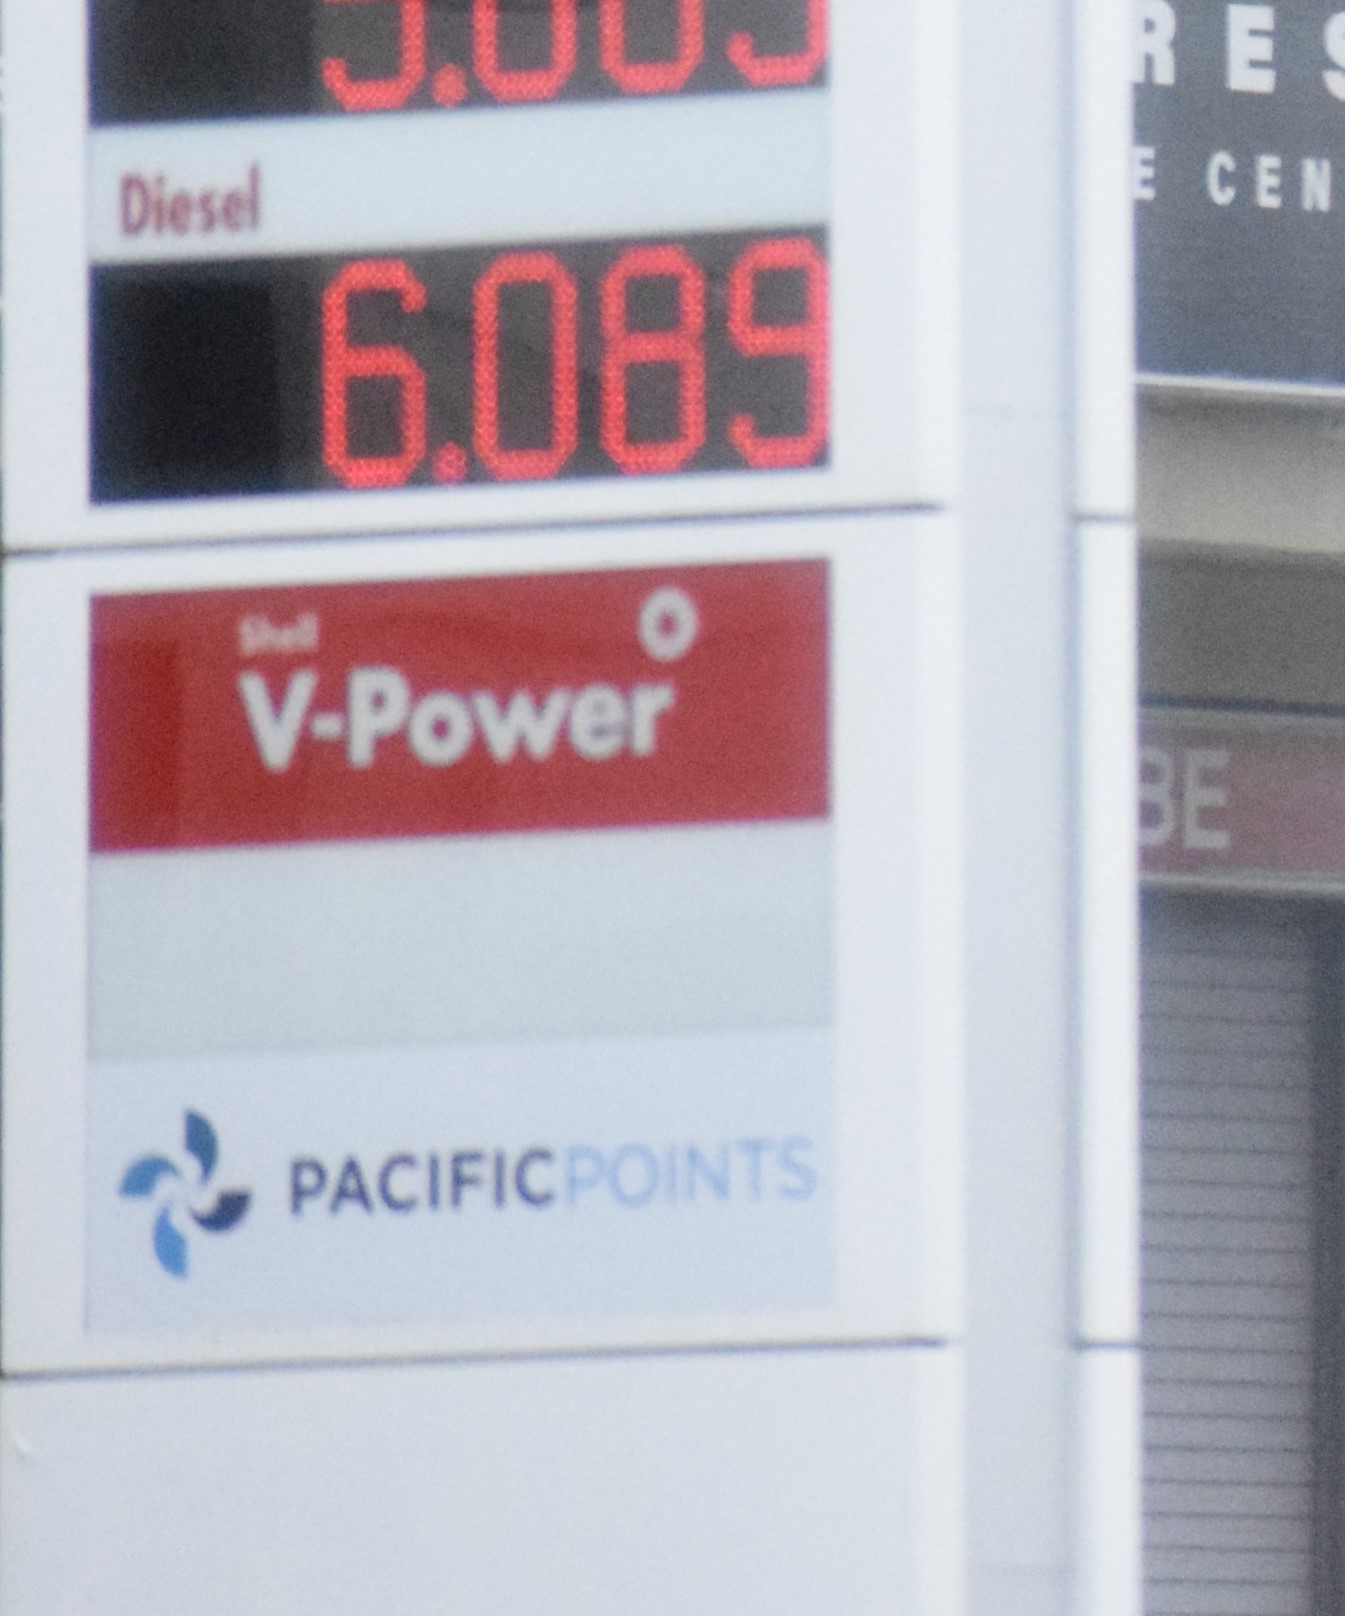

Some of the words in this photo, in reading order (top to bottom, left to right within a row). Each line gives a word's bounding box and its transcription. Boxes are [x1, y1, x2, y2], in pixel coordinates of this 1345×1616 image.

[119, 164, 261, 236] Diesel
[320, 237, 828, 489] 6.089
[238, 611, 319, 657] Shell
[237, 663, 675, 774] V-Power
[288, 1136, 818, 1217] PACIFICPOINTS
